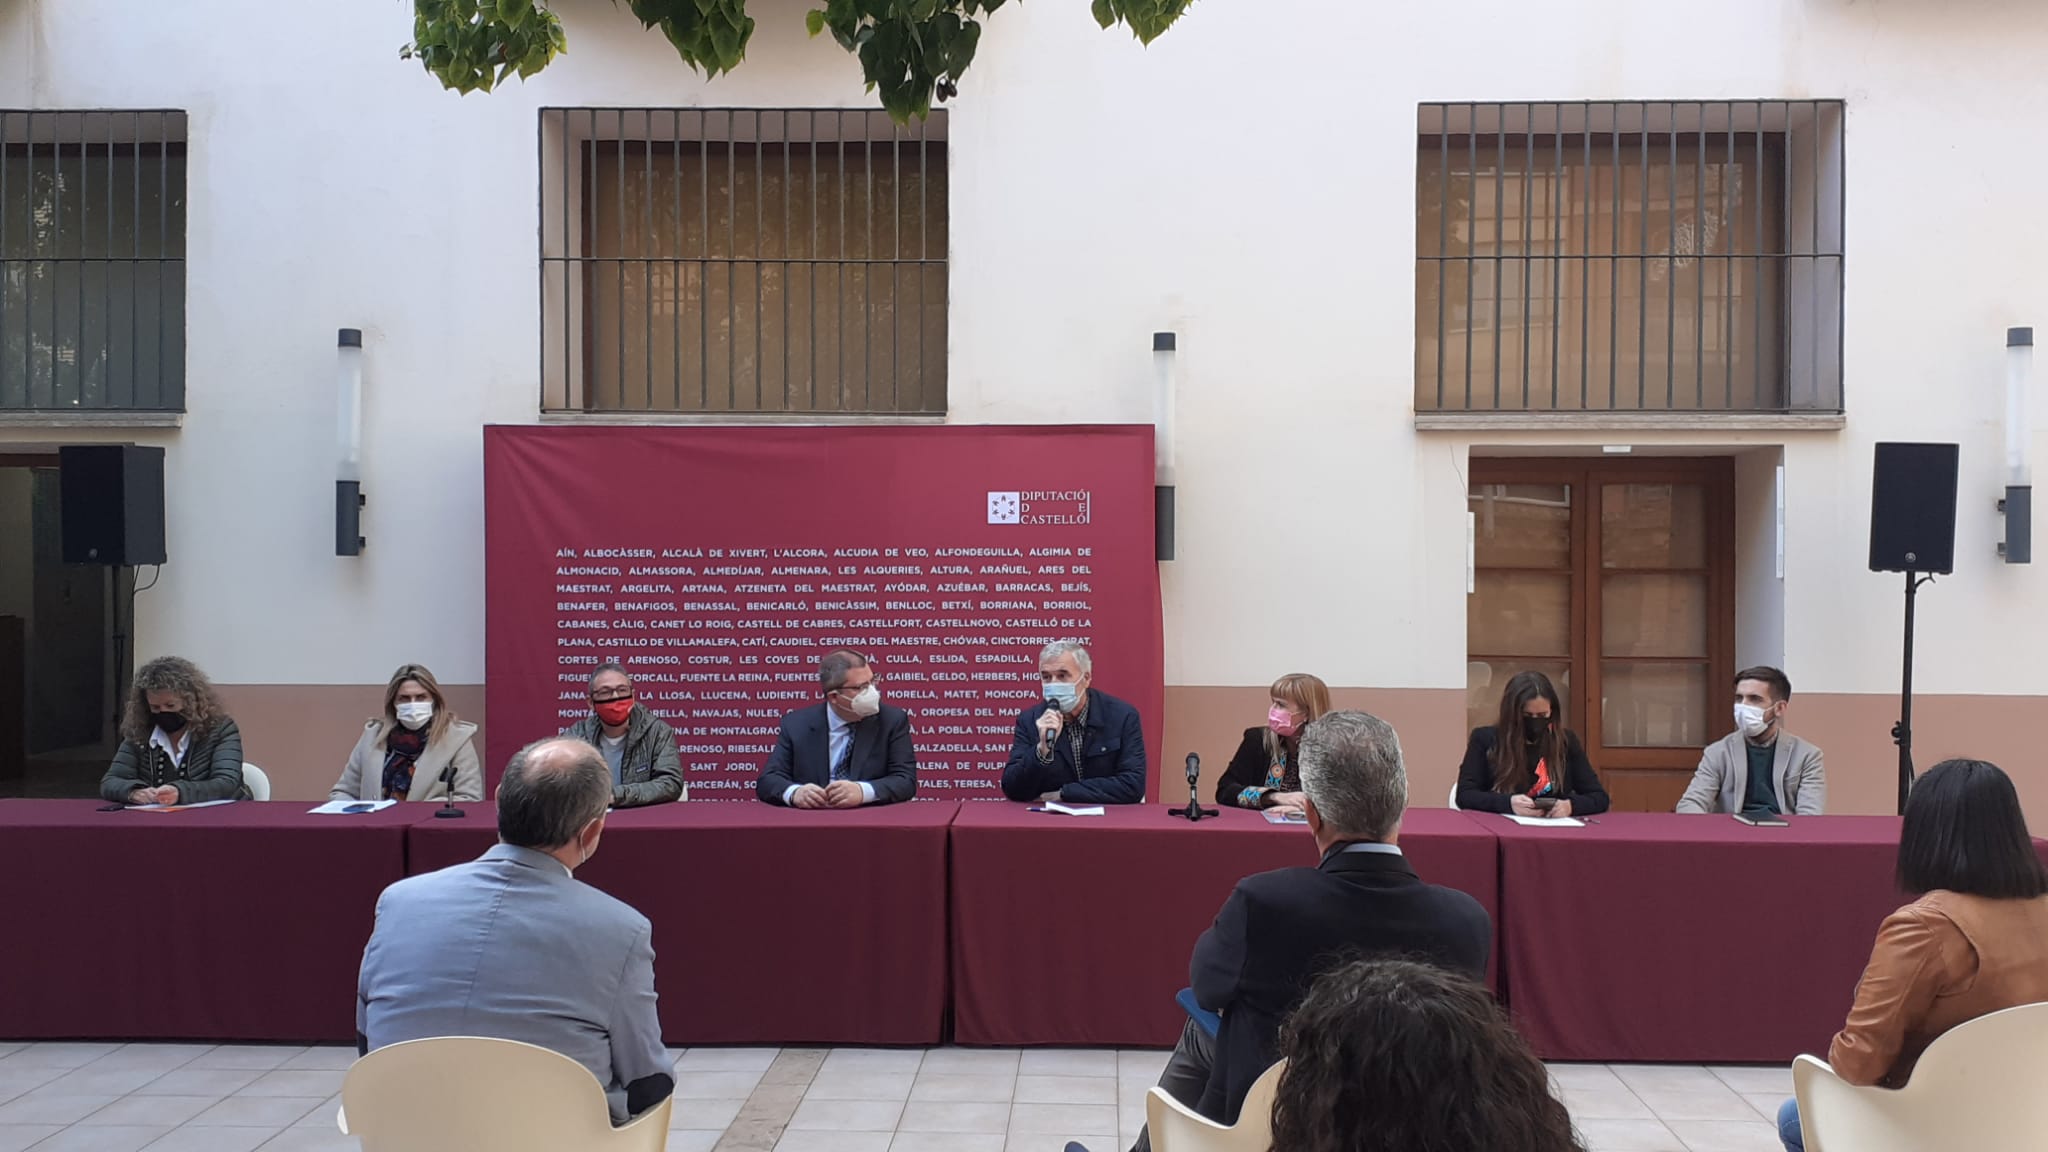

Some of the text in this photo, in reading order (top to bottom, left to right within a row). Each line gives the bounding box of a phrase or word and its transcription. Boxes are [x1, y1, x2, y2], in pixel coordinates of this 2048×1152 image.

[1021, 489, 1086, 501] DIPUTACIÓ
[1020, 512, 1086, 525] CASTELLÓ
[556, 546, 1092, 560] AÍN, ALBOCÀSSER, ALCALÀ DE XIVERT, L'ALCORA, ALCUDIA DE VEO, ALFONDEGUILLA, ALGIMIA DE
[556, 563, 1092, 578] ALMONACID, ALMASSORA, ALMEDÍJAR, ALMENARA, LES ALQUERIES, ALTURA, ARAÑUEL, ARES DEL
[556, 580, 1092, 596] MAESTRAT, ARGELITA, ARTANA, ATZENETA DEL MAESTRAT, AYÓDAR, AZUÉBAR, BARRACAS, BEJÍS,
[557, 599, 1092, 613] BENAFER, BENAFIGOS, BENASSAL, BENICARLÓ, BENICÀSSIM, BENLLOC, BETXÍ, BORRIANA, BORRIOL,
[557, 616, 1092, 631] CABANES, CÀLIG, CANET LO ROIG, CASTELL DE CABRES, CASTELLFORT, CASTELLNOVO, CASTELLÓ DE LA
[557, 637, 596, 649] PLANA,
[597, 637, 648, 647] CASTILLO
[650, 637, 664, 647] DE
[666, 637, 740, 649] VILLAMALEFA,
[741, 635, 768, 649] CATÍ,
[770, 637, 818, 649] CAUDIEL,
[819, 637, 867, 646] CERVERA
[869, 637, 889, 646] DEL
[891, 637, 942, 648] MAESTRE,
[943, 634, 989, 648] CHÓVAR,
[558, 655, 598, 665] CORTES
[606, 655, 620, 665] DE
[627, 655, 681, 667] ARENOSO,
[688, 655, 732, 667] COSTUR,
[739, 655, 758, 665] LES
[765, 655, 800, 665] COVES
[806, 655, 820, 664] DE
[886, 654, 922, 666] CULLA,
[929, 654, 968, 666] ESLIDA,
[975, 654, 1033, 665] ESPADILLA,
[558, 673, 591, 683] FIGUE
[680, 673, 721, 683] FUENTE
[722, 673, 736, 683] LA
[738, 673, 773, 685] REINA,
[886, 672, 930, 684] GAIBIEL,
[931, 672, 969, 684] GELDO,
[971, 672, 1020, 683] HERBERS,
[640, 691, 654, 700] LA
[659, 691, 696, 702] LLOSA,
[700, 691, 751, 702] LLUCENA,
[756, 691, 810, 702] LUDIENTE,
[887, 690, 939, 702] MORELLA,
[944, 690, 980, 701] MATET,
[984, 690, 1039, 701] MONCOFA,
[650, 709, 688, 720] RELLA,
[692, 709, 742, 720] NAVAJAS,
[746, 709, 782, 720] NULES,
[920, 708, 970, 717] OROPESA
[974, 707, 994, 717] DEL
[693, 726, 707, 736] DE
[921, 726, 935, 735] LA
[938, 725, 973, 735] POBLA
[976, 725, 1016, 735] TORNES
[678, 744, 726, 756] RENOSO,
[728, 744, 776, 754] RIBESAL
[913, 743, 983, 755] SALZADELLA,
[984, 743, 1006, 753] SAN
[690, 762, 718, 772] SANT
[724, 762, 759, 774] JORDI,
[956, 761, 970, 771] DE
[917, 779, 952, 790] TALES,
[953, 779, 996, 790] TERESA,
